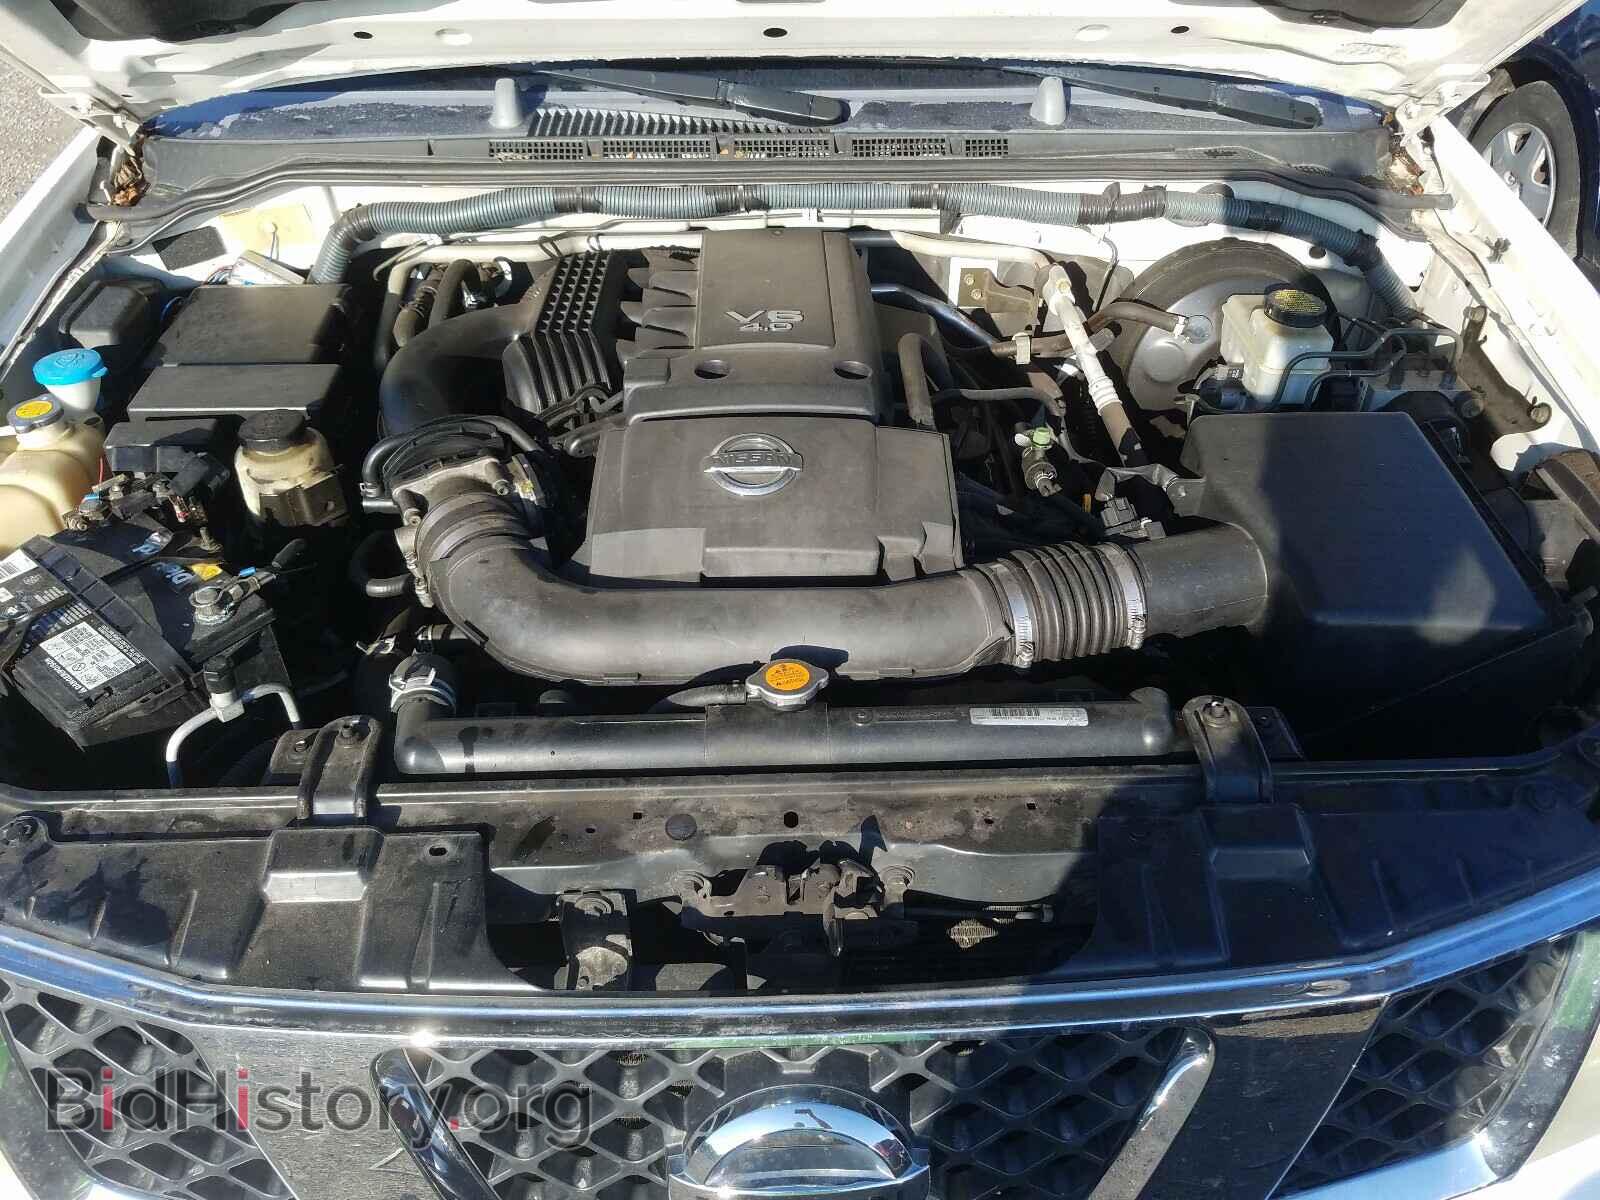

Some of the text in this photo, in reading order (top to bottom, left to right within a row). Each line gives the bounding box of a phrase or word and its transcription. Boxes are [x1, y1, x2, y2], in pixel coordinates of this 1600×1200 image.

[724, 310, 805, 322] V6
[739, 322, 793, 332] 4.0
[712, 453, 791, 464] NISSAN
